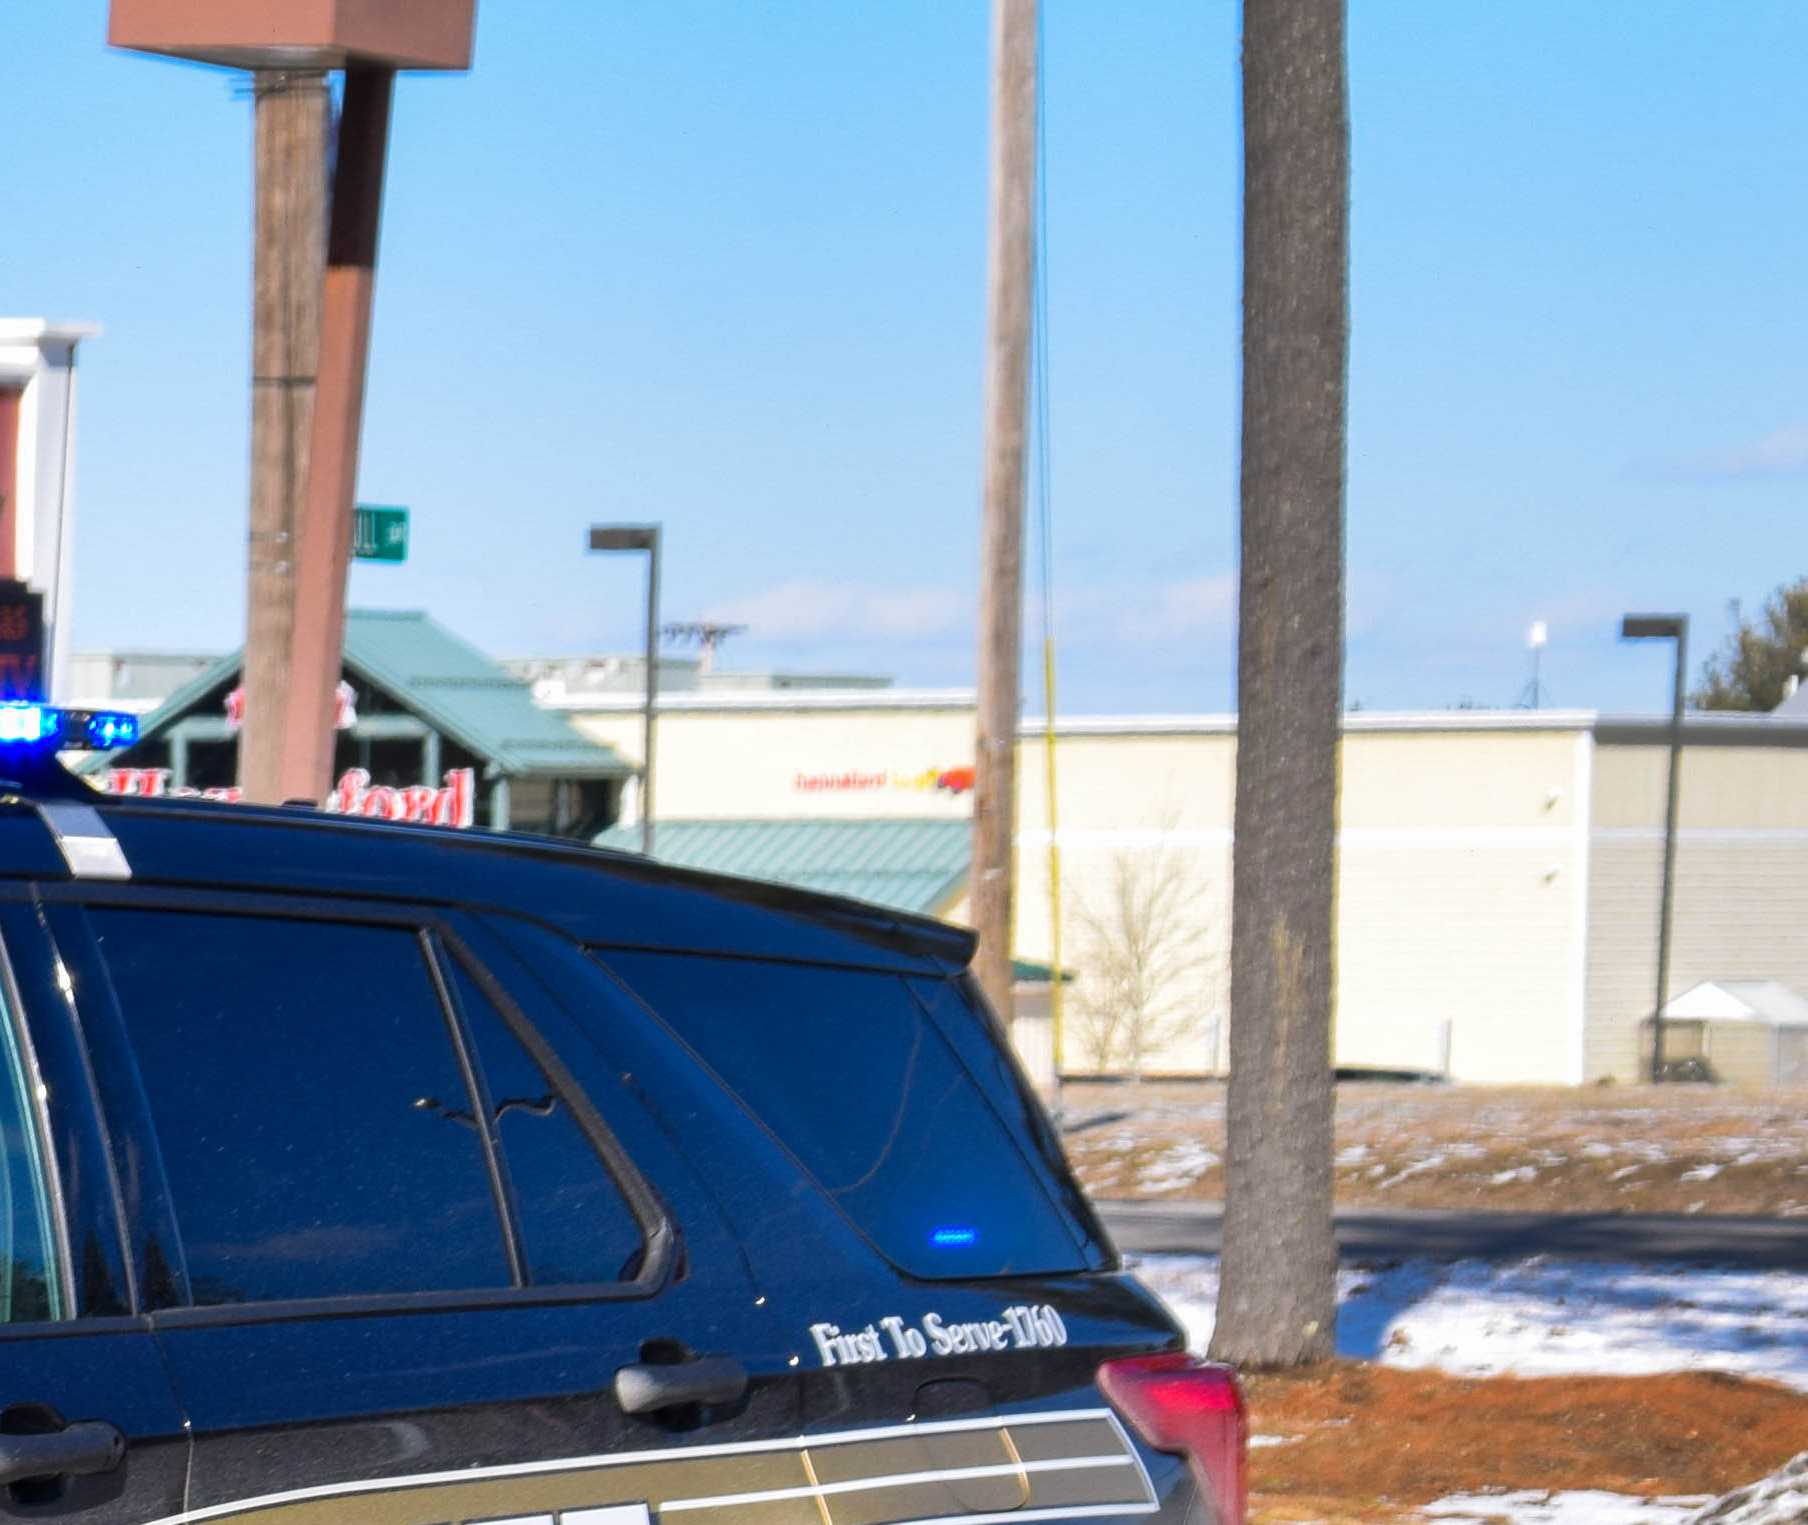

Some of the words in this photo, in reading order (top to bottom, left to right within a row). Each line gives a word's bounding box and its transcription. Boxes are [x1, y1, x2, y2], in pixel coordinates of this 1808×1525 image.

[809, 1322, 887, 1366] First
[880, 1316, 927, 1359] To
[922, 1304, 1068, 1355] Serve-1760
